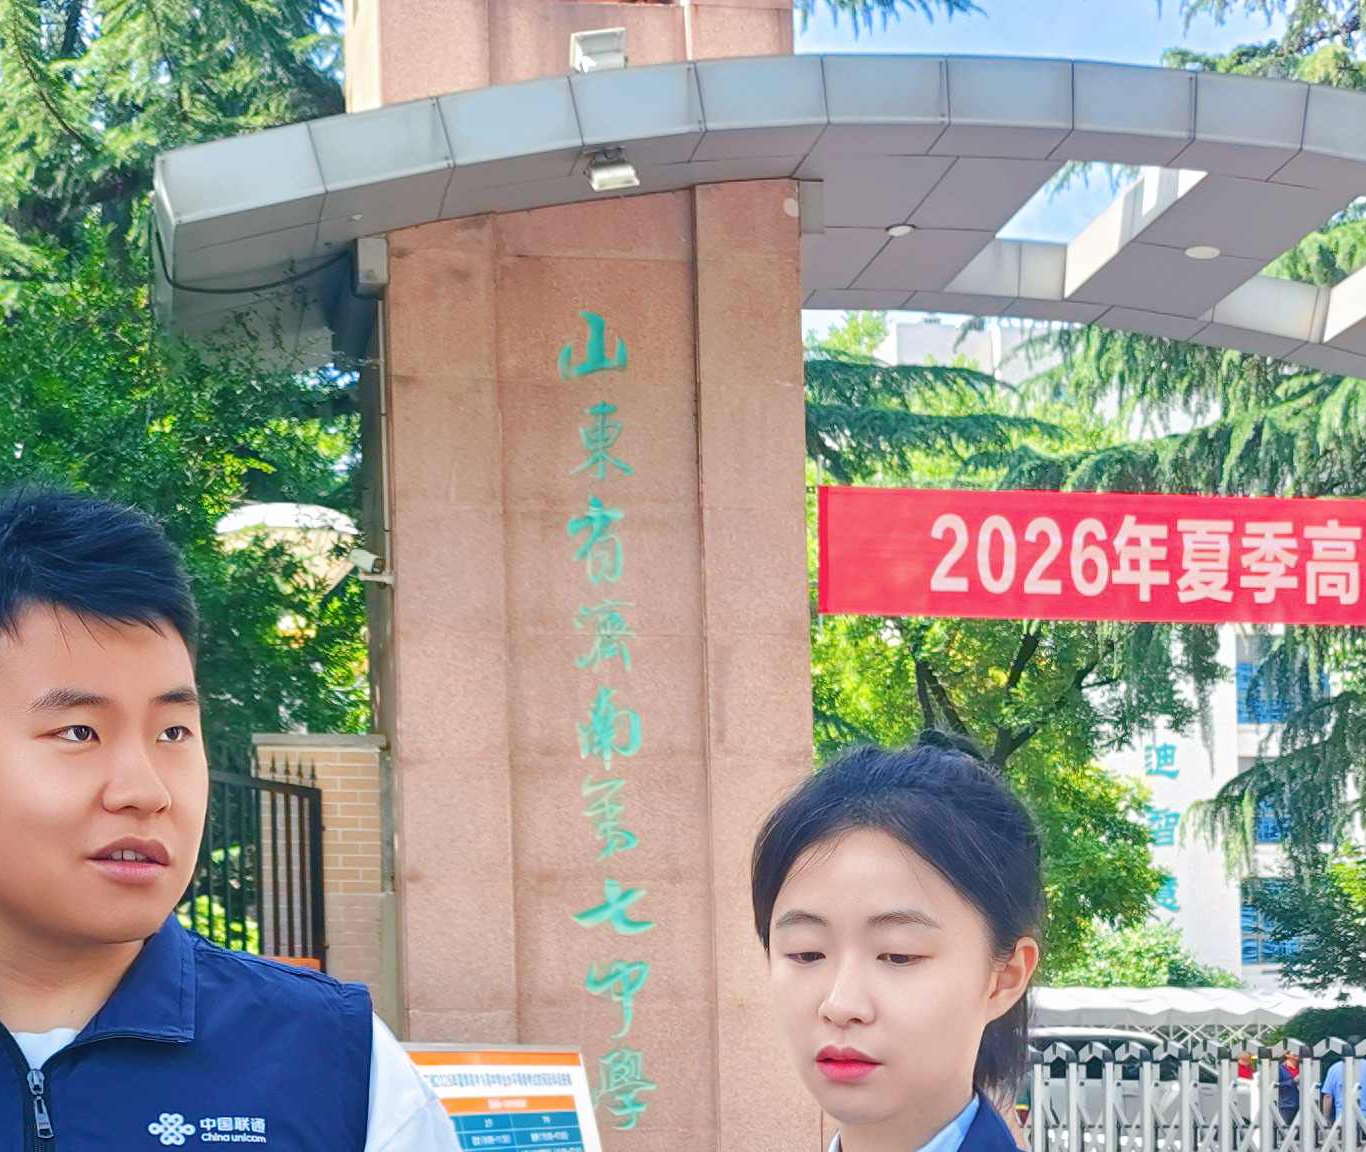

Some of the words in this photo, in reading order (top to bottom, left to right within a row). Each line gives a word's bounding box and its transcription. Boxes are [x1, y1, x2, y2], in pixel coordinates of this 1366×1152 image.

[200, 1117, 266, 1133] 中国联通
[201, 1132, 230, 1143] China
[231, 1133, 266, 1144] unicom
